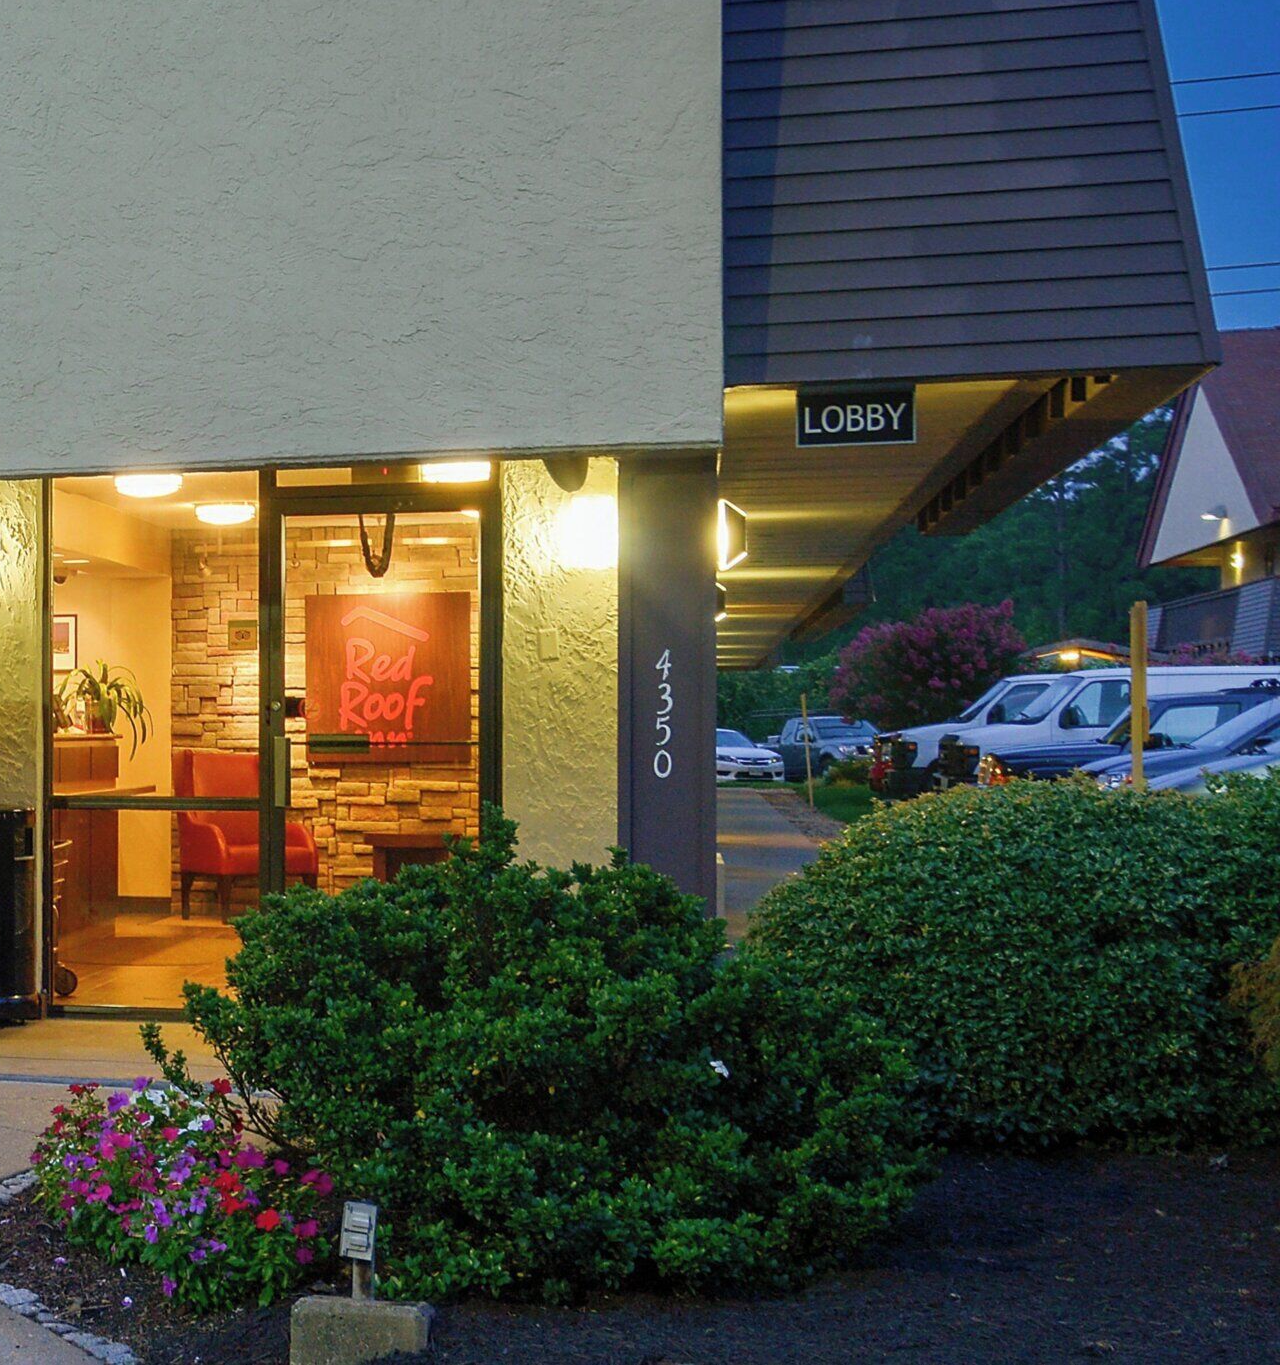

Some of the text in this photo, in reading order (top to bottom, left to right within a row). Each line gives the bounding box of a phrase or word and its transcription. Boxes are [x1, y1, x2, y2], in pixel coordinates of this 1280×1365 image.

[804, 402, 907, 434] LOBBY
[345, 637, 416, 684] Red
[338, 675, 434, 731] Roof
[653, 648, 674, 779] 4350
[354, 730, 414, 748] nn
